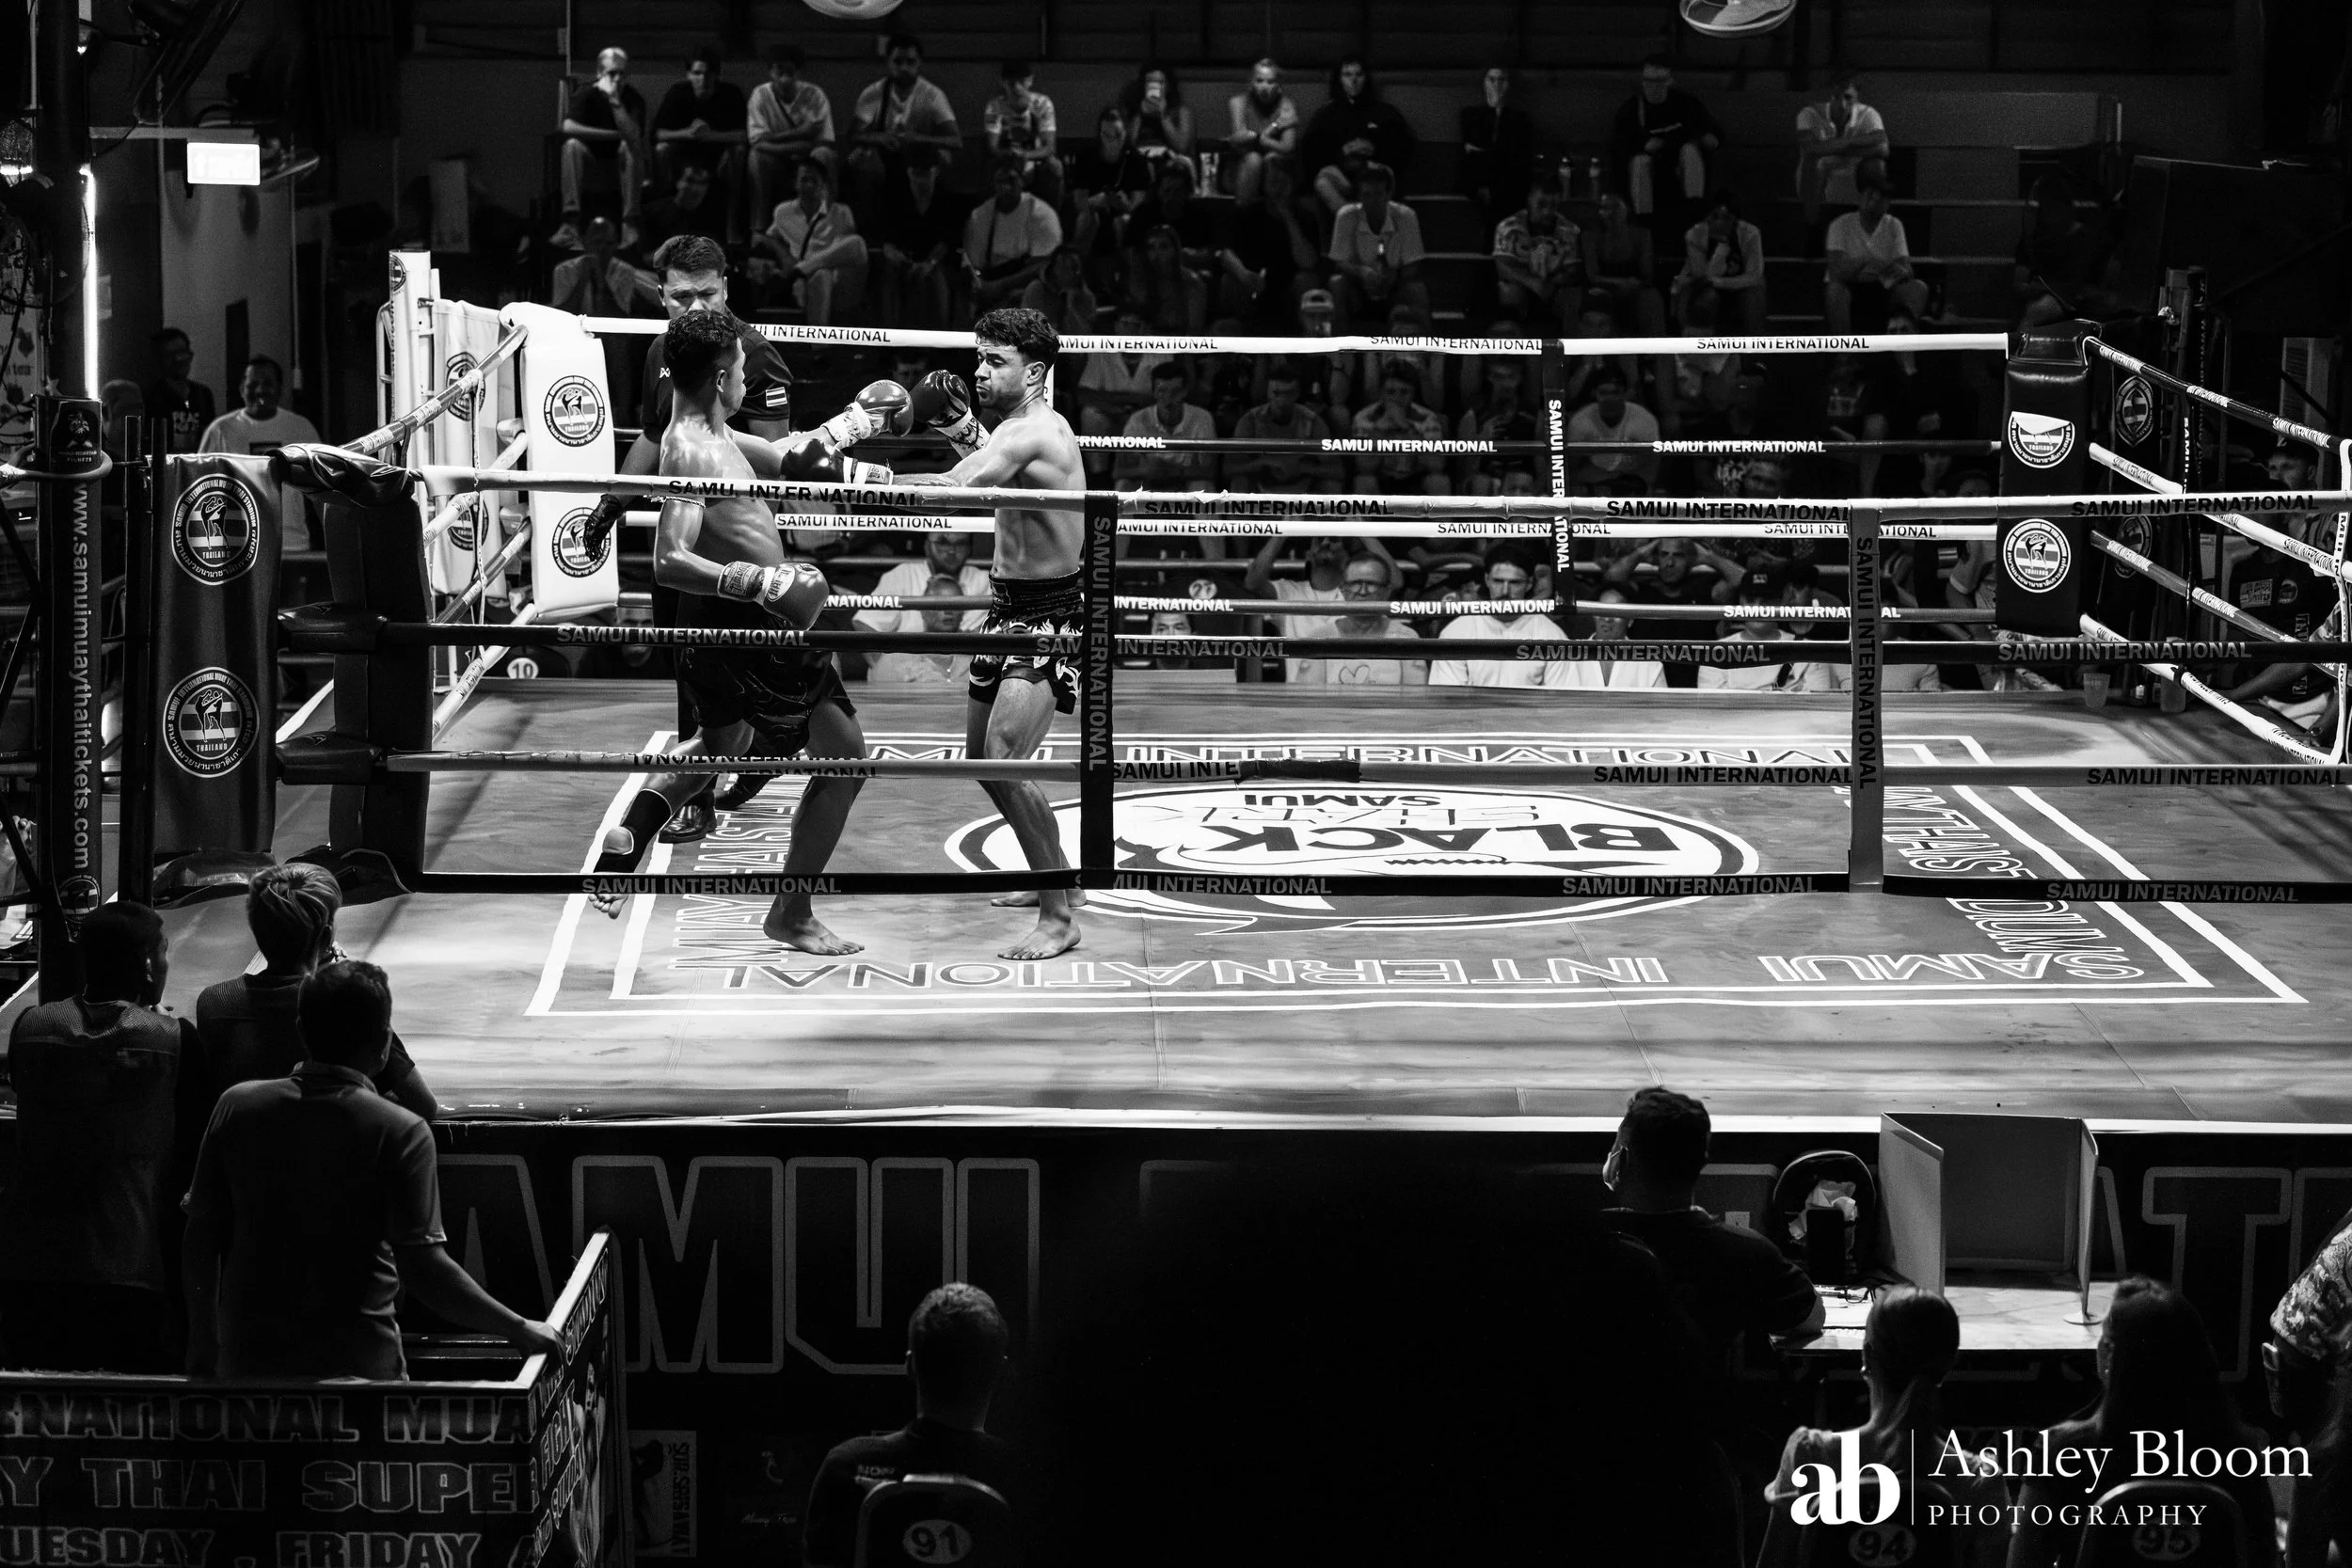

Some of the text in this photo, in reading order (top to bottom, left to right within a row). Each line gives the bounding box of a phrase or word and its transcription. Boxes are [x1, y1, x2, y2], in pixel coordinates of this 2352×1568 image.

[773, 326, 891, 342] INTERNATIONAL
[1060, 338, 1218, 350] MUI INTERNATIONAL
[1423, 338, 1543, 351] INTERNATIONAL
[1697, 337, 1869, 350] SAMUI INTERNATIONAL
[1076, 436, 1167, 449] ERNATIONAL
[1322, 439, 1498, 452] SAMUI INTERNATIONAL
[1653, 440, 1827, 452] SAMUI INTERNATIONAL
[1549, 399, 1572, 573] SAMUI INTERTIONAL
[1607, 500, 1850, 521] SAMUI INTERNATIONAL
[2072, 494, 2320, 516] SAMUI INTERNATIONAL
[776, 515, 953, 530] SAMUI INTERNATIONAL
[1118, 521, 1283, 535] AMUI INTERNATIONAL
[1438, 523, 1488, 534] SAMUI
[825, 595, 902, 609] NATIONAL
[1114, 596, 1233, 611] INTERNATIONAL
[1391, 600, 1555, 614] SAMUI INTERNATIONA
[1724, 605, 1776, 618] SAMUI
[557, 626, 810, 646] SAMUI INTERNATIONAL
[1087, 516, 1111, 771] SAMUI INTERNATIONAL
[1037, 638, 1082, 654] SAM
[1117, 640, 1290, 657] INTERNATIONAL
[1517, 644, 1771, 662] SAMUI INTERNATIONAL
[1998, 642, 2252, 661] SAMUI INTERNATIONAL
[1855, 537, 1877, 790] SAMUI INTERNATIONAL
[1594, 766, 1853, 785] SAMUI INTERNATIONAL
[2087, 768, 2347, 786] SAMUI INTERNATIONAL
[1244, 794, 1441, 807] SAMUI
[1200, 823, 1681, 852] BLACK
[582, 877, 842, 895] SAMUI INTERNATIONAL
[1157, 876, 1332, 895] INTERNATIONAL
[1563, 877, 1819, 895] SAMUI INTERNATIONAL
[2046, 883, 2299, 902] SAMUI INTERNATIONAL
[723, 952, 2145, 990] SAMUI INTERNATIONAL
[80, 1459, 266, 1512] THAI
[275, 1530, 482, 1568] FRIDAY
[911, 1524, 960, 1557] 91
[1855, 1530, 1908, 1561] 94
[2138, 1525, 2189, 1557] 95
